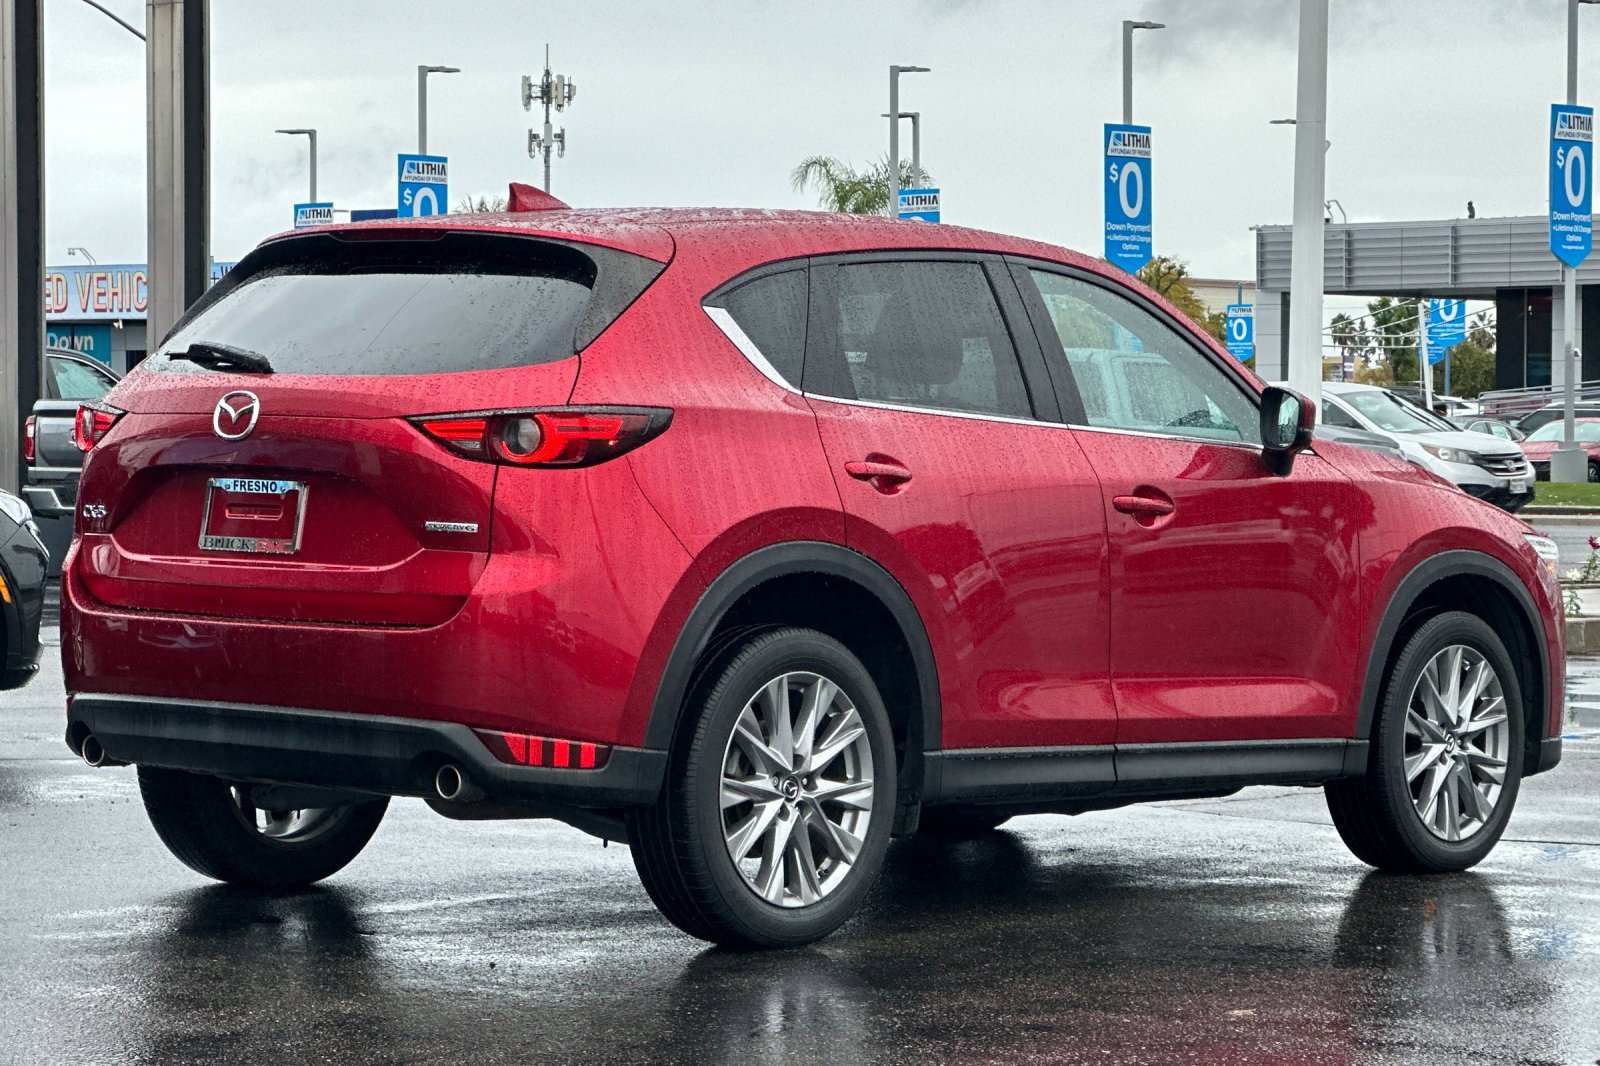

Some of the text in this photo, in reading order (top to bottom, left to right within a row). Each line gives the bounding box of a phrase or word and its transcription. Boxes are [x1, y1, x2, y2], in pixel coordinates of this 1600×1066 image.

[1568, 114, 1592, 131] LITHIA
[1122, 133, 1151, 148] LITHIA
[416, 162, 447, 176] LITHIA
[907, 194, 939, 206] LITHIA
[305, 208, 332, 219] LITHIA
[1553, 211, 1570, 221] Down
[1106, 221, 1126, 231] Down
[46, 332, 94, 350] Down
[233, 480, 278, 493] FRESNO
